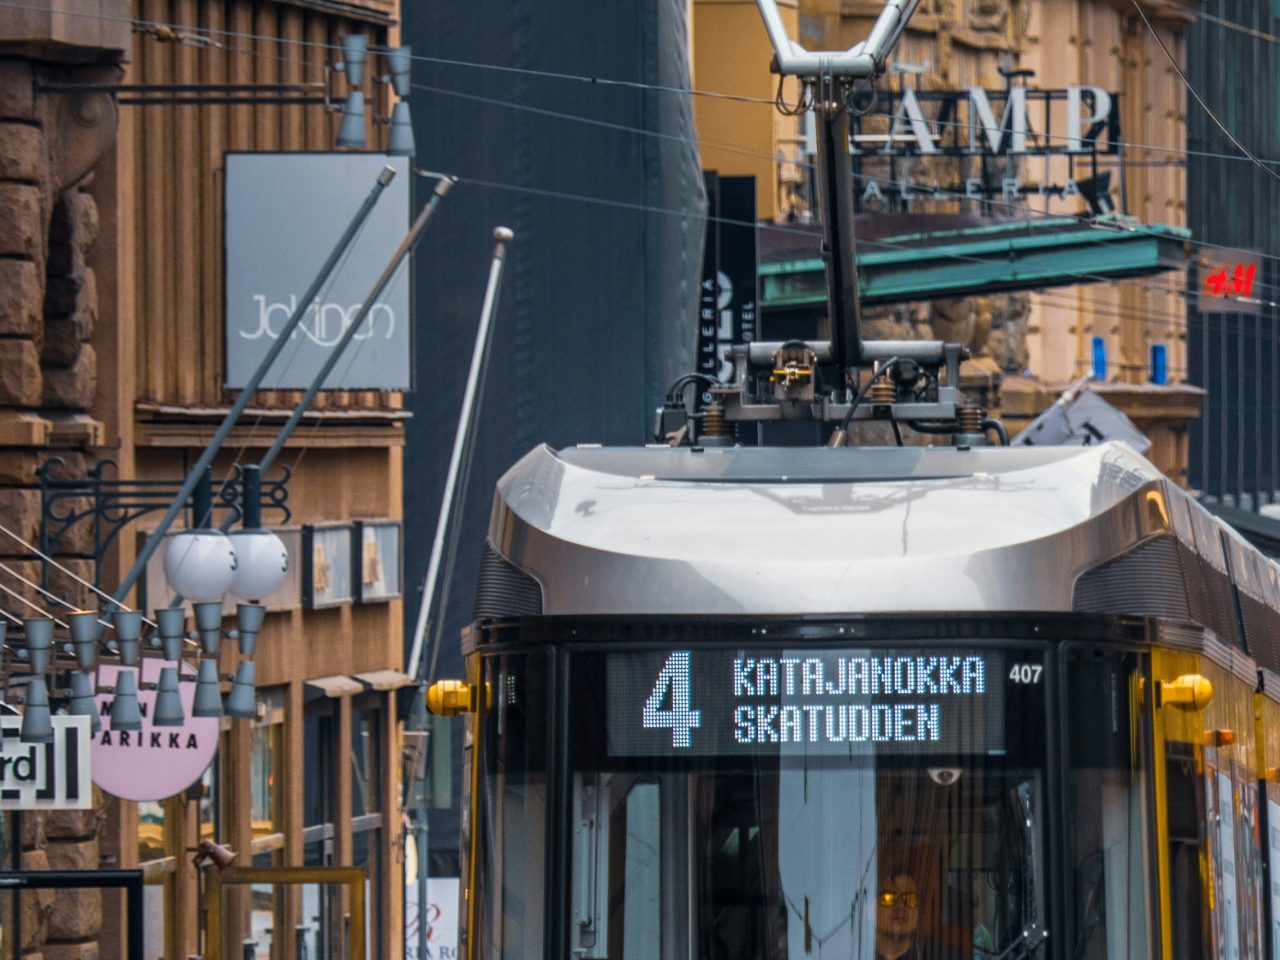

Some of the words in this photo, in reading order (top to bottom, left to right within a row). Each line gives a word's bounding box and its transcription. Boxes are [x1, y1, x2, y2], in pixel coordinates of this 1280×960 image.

[860, 177, 1081, 201] ALLERIA
[742, 301, 754, 342] OTEL
[1009, 664, 1042, 684] 407
[100, 702, 148, 717] MN
[642, 651, 700, 748] 4
[734, 656, 986, 696] KATAJANOKKA
[734, 703, 941, 743] SKATUDDEN
[91, 730, 198, 749] ARIKKA
